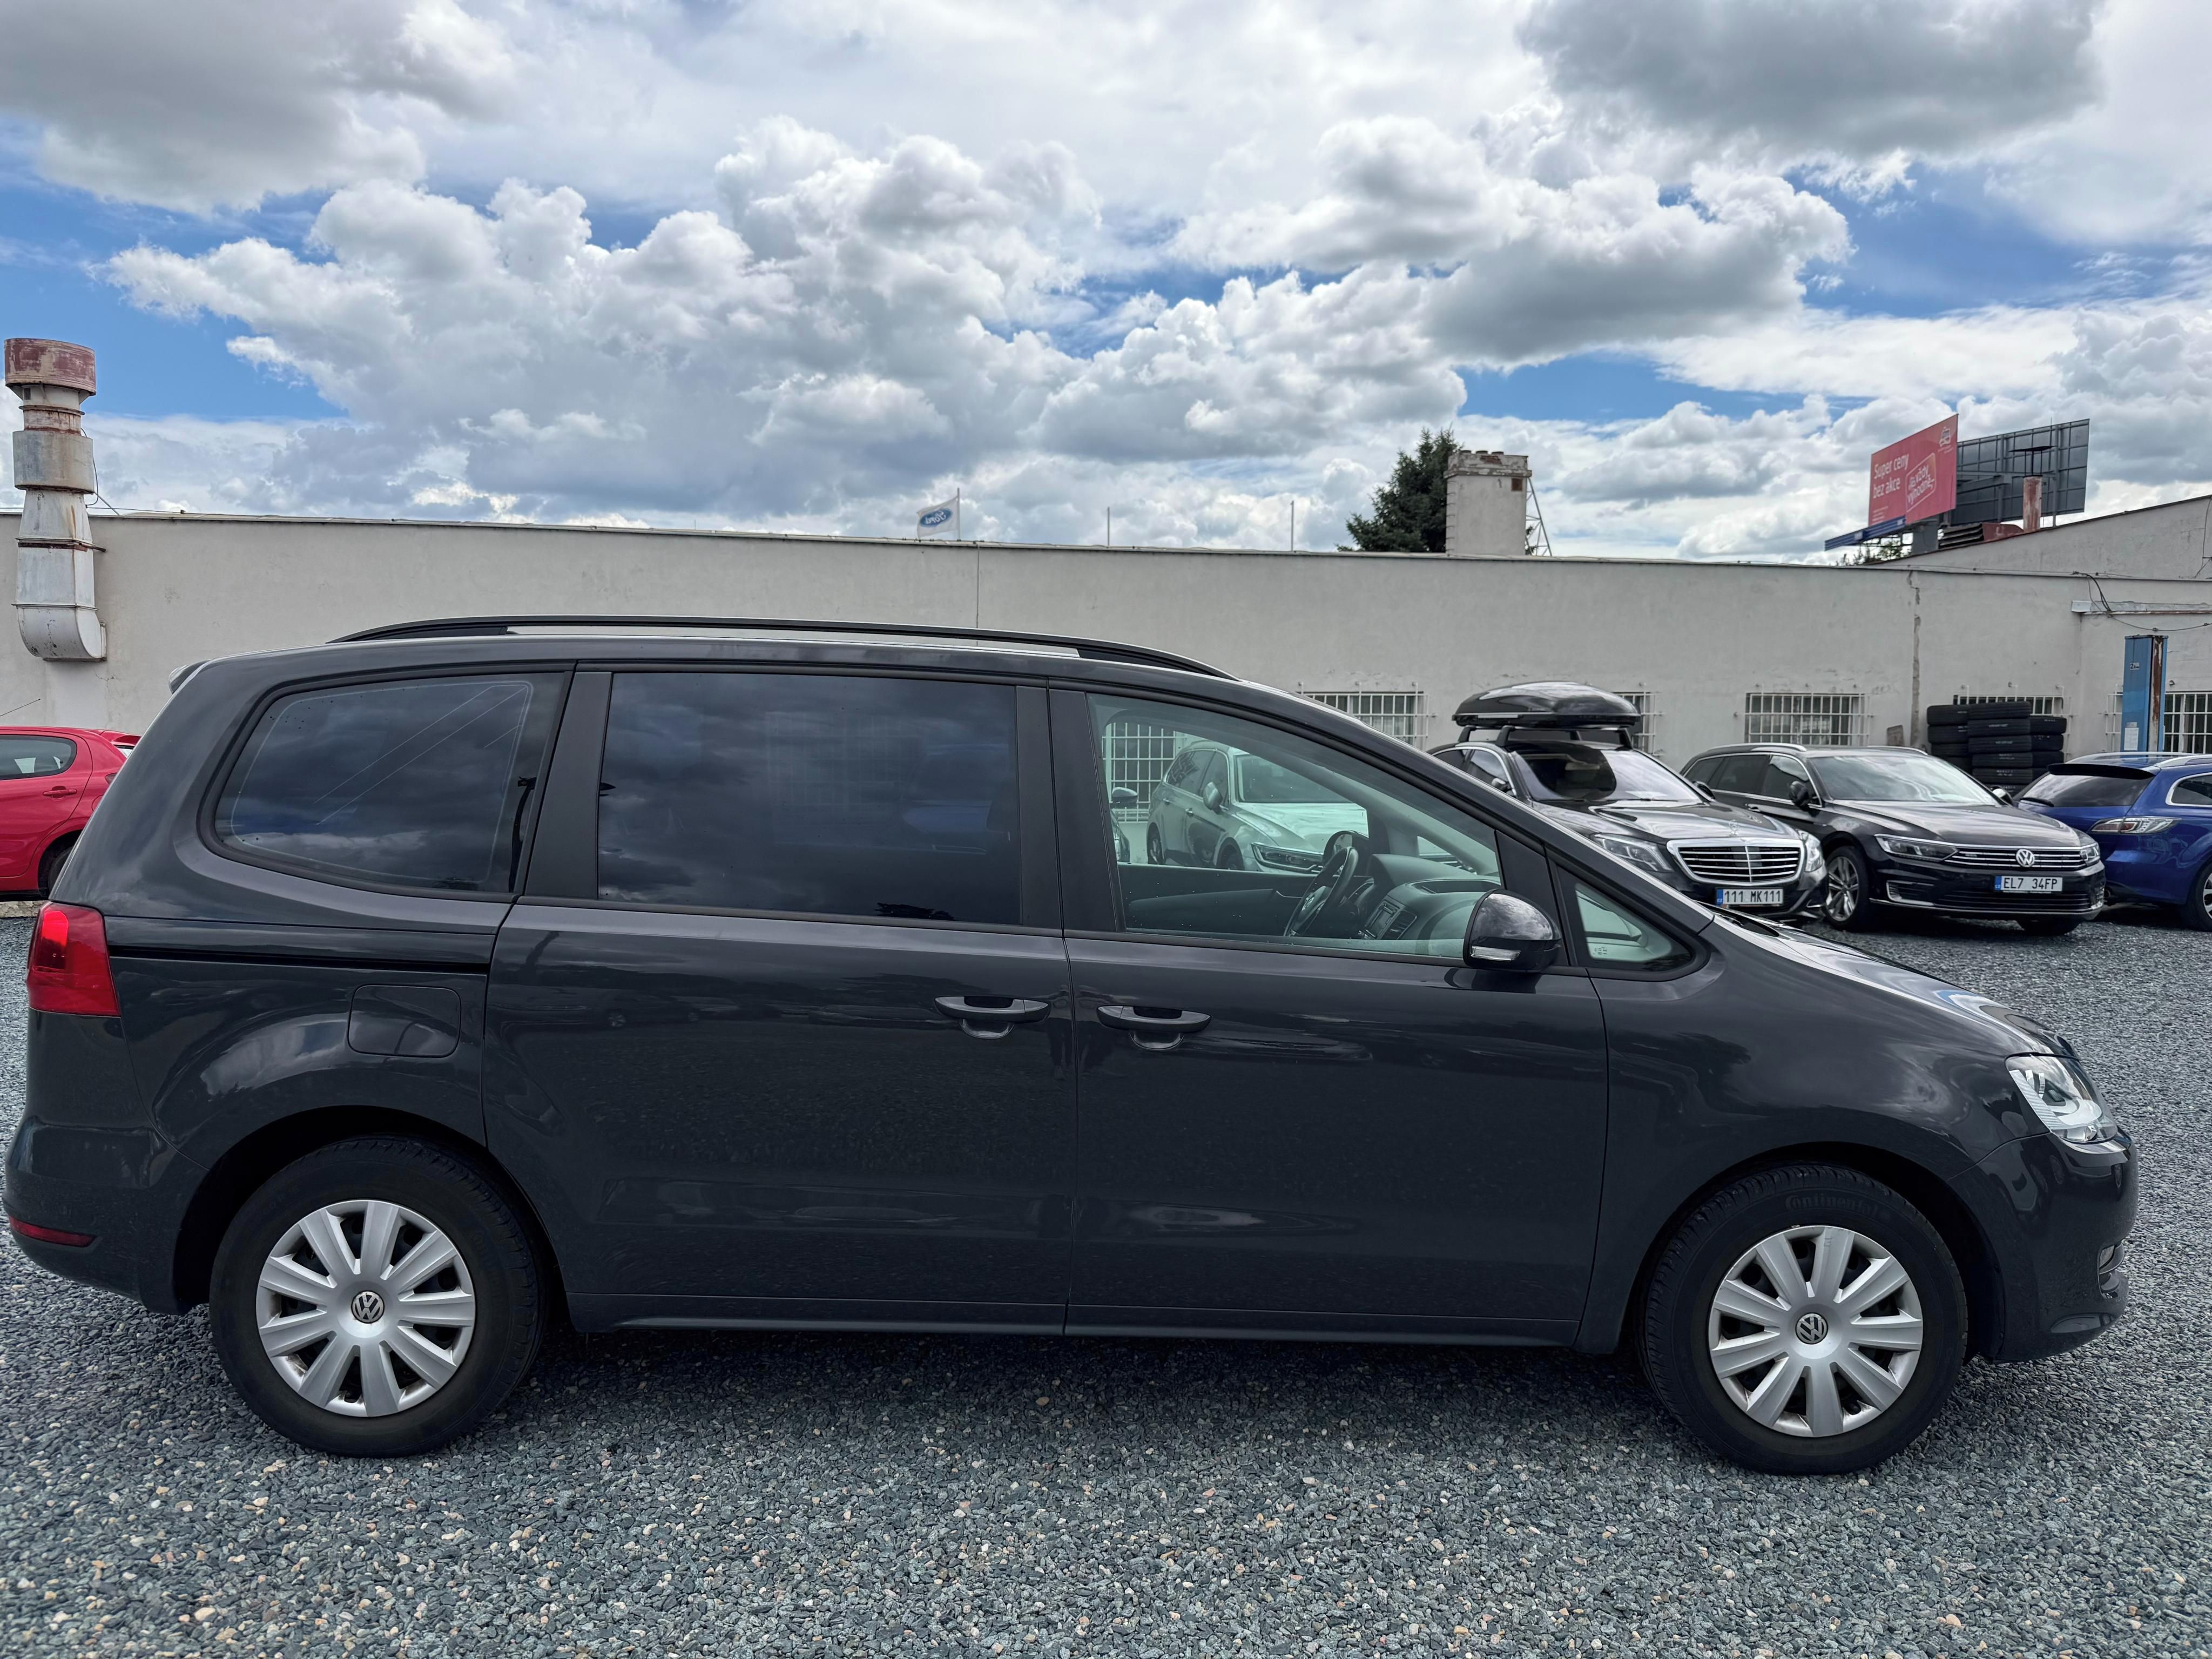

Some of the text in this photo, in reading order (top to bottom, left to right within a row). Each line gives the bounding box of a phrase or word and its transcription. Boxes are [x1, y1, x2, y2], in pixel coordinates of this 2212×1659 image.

[1874, 453, 1910, 479] Super ceny
[1873, 477, 1901, 498] bez akce
[2004, 878, 2058, 889] EL7 34FP
[1724, 890, 1781, 902] 111 MK111
[1785, 1192, 1879, 1216] Continental
